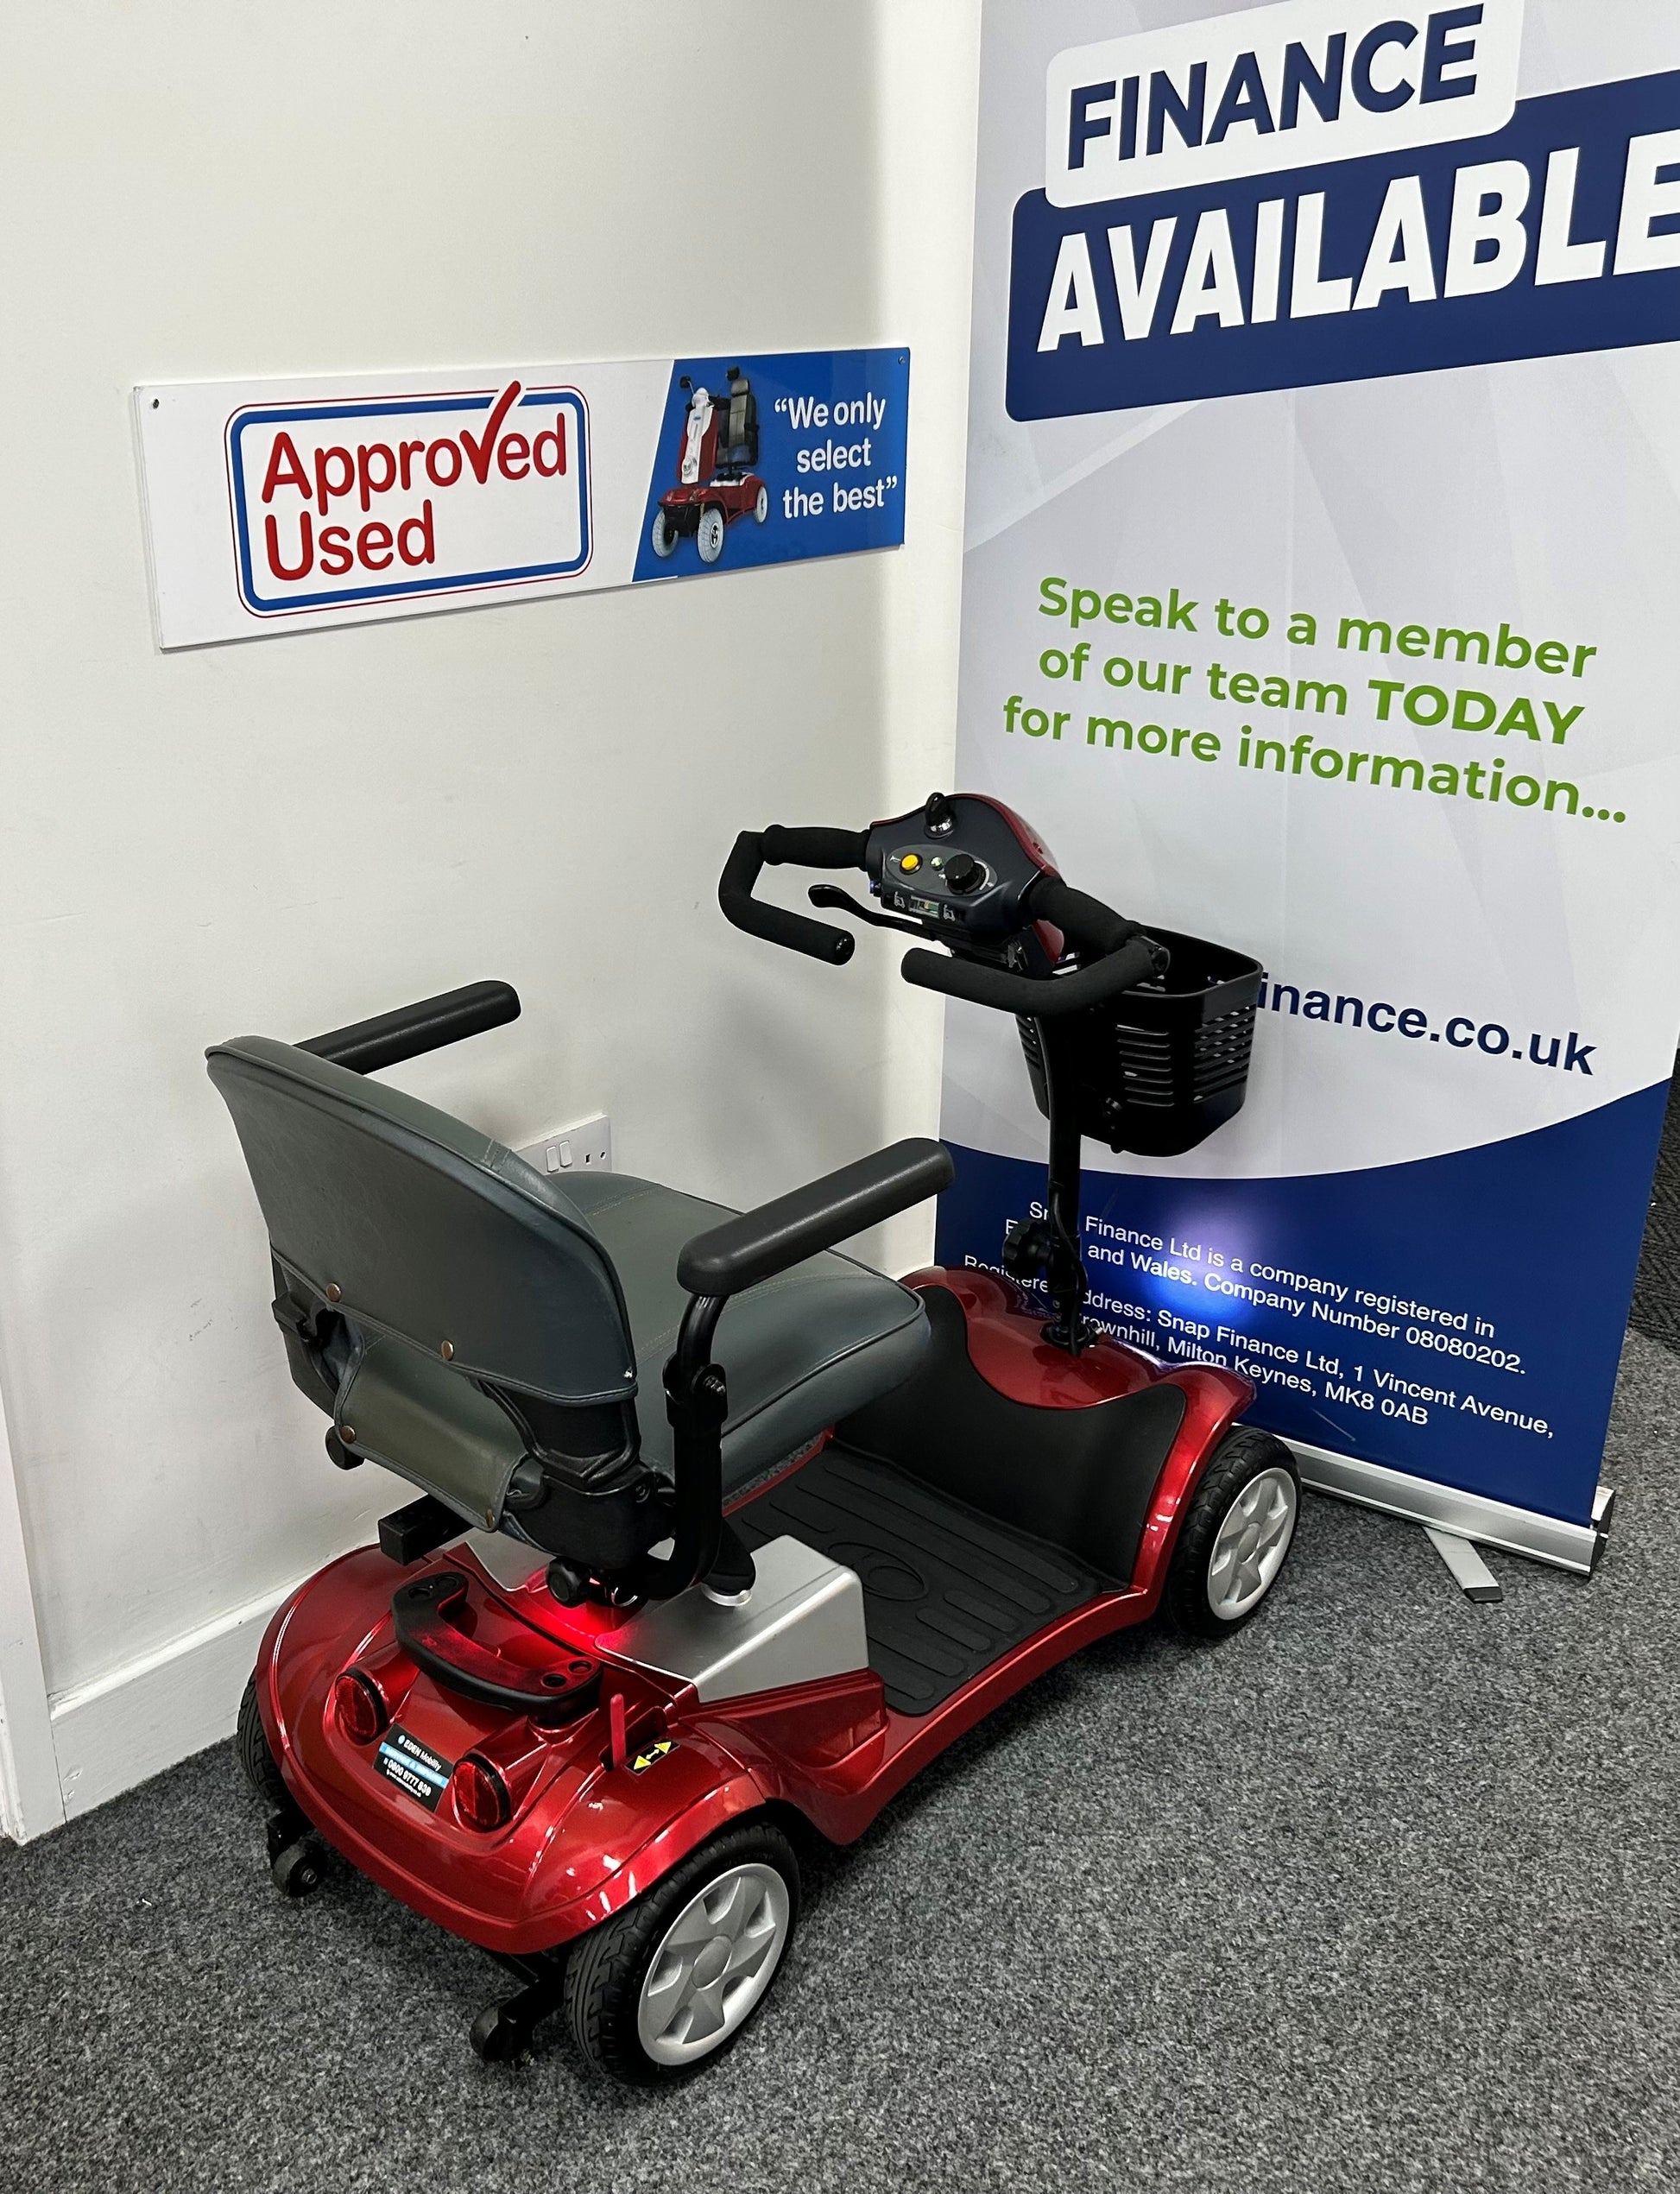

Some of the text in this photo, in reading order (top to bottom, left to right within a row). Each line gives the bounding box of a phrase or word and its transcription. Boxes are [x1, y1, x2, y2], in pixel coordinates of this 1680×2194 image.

[1068, 3, 1484, 171] FINANCE
[1036, 129, 1680, 353] AVAILABLE
[262, 380, 566, 516] Approved
[774, 392, 886, 431] “We only
[797, 438, 871, 473] select
[265, 499, 435, 580] Used
[783, 476, 898, 519] the best”
[1038, 576, 1598, 679] Speak to a member
[1039, 642, 1585, 746] of our team TODAY
[1002, 695, 1627, 824] for more information...
[1257, 971, 1597, 1076] inance.co.uk
[1086, 1216, 1495, 1338] Finance Ltd is a company registered in
[1088, 1244, 1525, 1375] and Wales. Company Number 08080202.
[1080, 1313, 1160, 1351] rownhill,
[1167, 1336, 1227, 1367] Milton
[1235, 1356, 1317, 1397] Keynes,
[1324, 1382, 1374, 1411] MK8
[1083, 1290, 1151, 1313] ddress:
[1157, 1309, 1209, 1340] Snap
[1216, 1325, 1299, 1363] Finance
[1305, 1350, 1344, 1379] Ltd,
[1354, 1365, 1363, 1382] 1
[1373, 1368, 1456, 1408] Vincent
[1460, 1394, 1554, 1439] Avenue,
